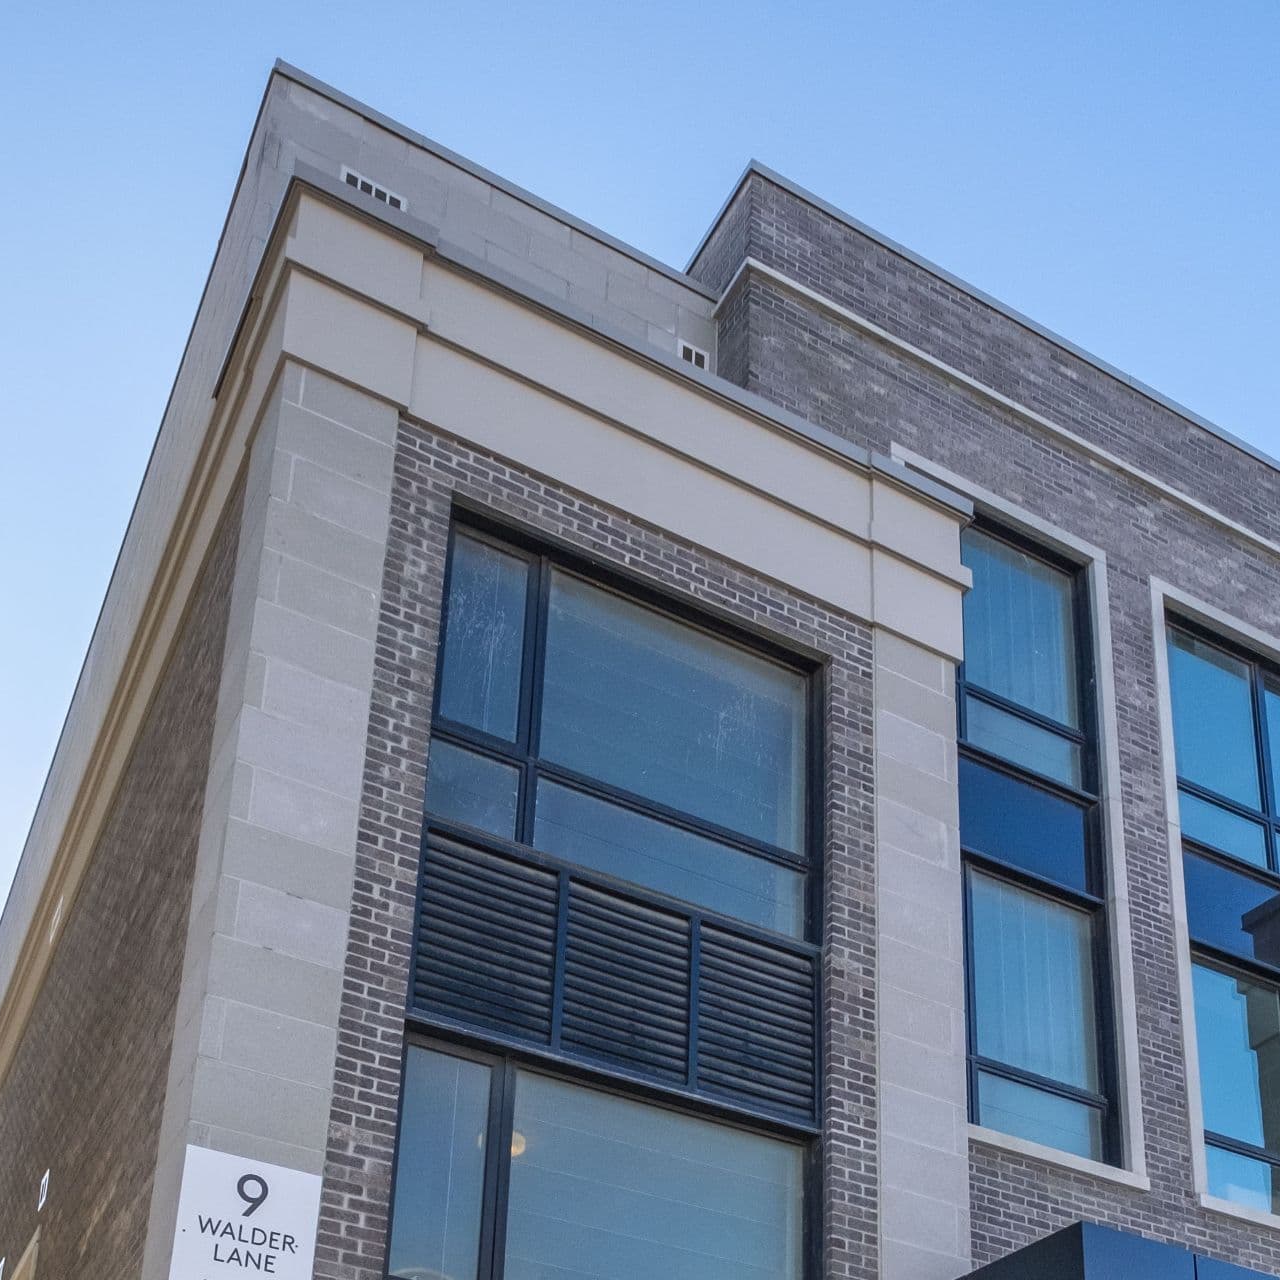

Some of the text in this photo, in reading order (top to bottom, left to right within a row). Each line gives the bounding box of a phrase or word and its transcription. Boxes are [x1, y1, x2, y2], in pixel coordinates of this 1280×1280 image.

[236, 1173, 269, 1217] 9
[198, 1214, 296, 1254] WALDER
[213, 1243, 276, 1274] LANE
